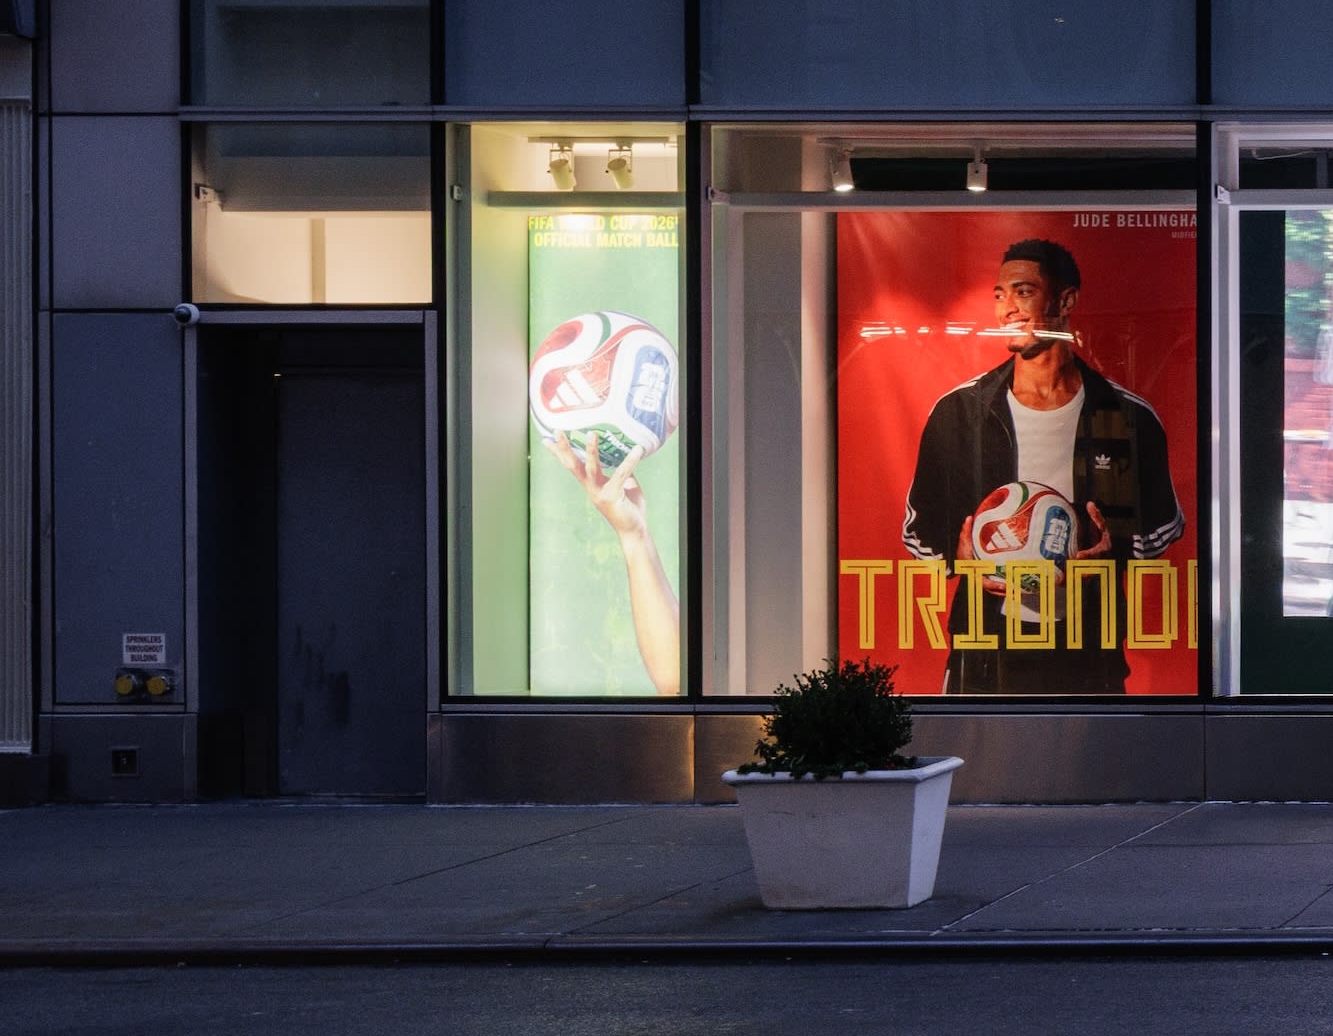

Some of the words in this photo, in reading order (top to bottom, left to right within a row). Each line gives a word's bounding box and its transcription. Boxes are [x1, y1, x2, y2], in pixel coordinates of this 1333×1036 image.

[529, 216, 555, 231] FIFA
[1072, 214, 1111, 228] JUDE
[1116, 214, 1197, 228] BELLINGHA
[534, 232, 593, 249] OFFICIAL
[596, 232, 642, 249] MATCH
[646, 232, 678, 249] BALL
[126, 635, 162, 644] SPRINKLERS
[125, 644, 164, 653] THROUGHOUT
[130, 653, 158, 662] BUILDING
